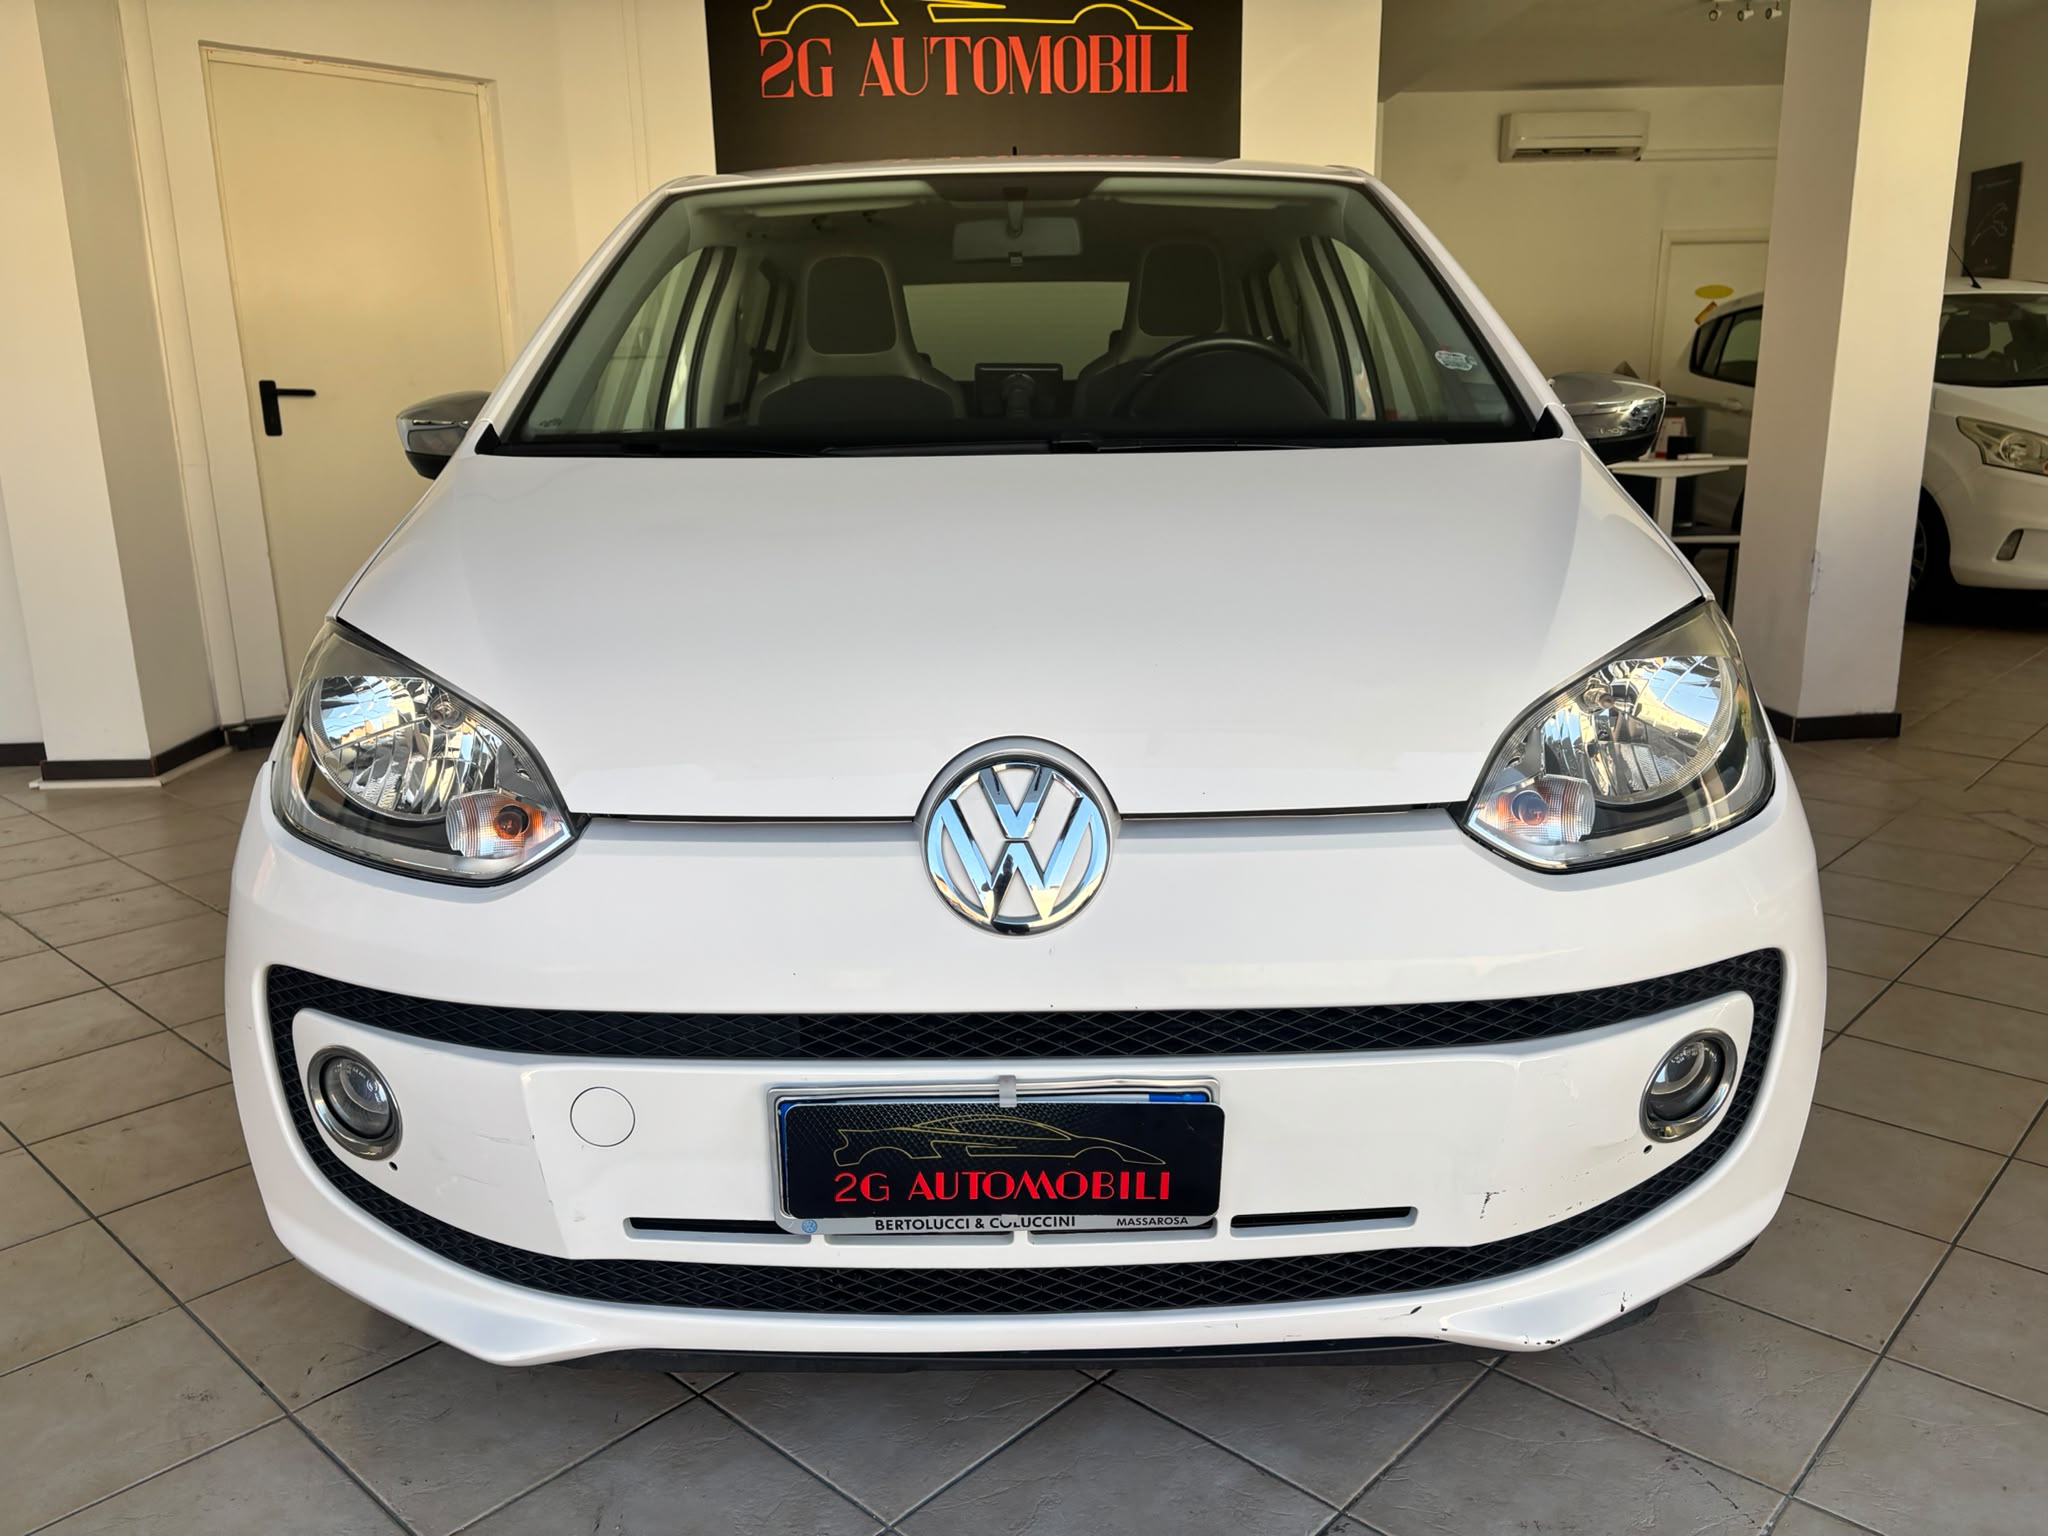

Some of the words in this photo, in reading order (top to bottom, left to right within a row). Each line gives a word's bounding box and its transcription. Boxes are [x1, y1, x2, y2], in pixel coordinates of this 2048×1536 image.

[758, 37, 833, 99] 2G
[859, 34, 1189, 97] AUTOMOBILI
[834, 1172, 890, 1202] 2G
[908, 1170, 1170, 1201] AUTOMOBILI
[875, 1218, 970, 1231] BERTOLUCCI
[975, 1218, 985, 1229] &
[1116, 1216, 1189, 1227] MASSAROSA
